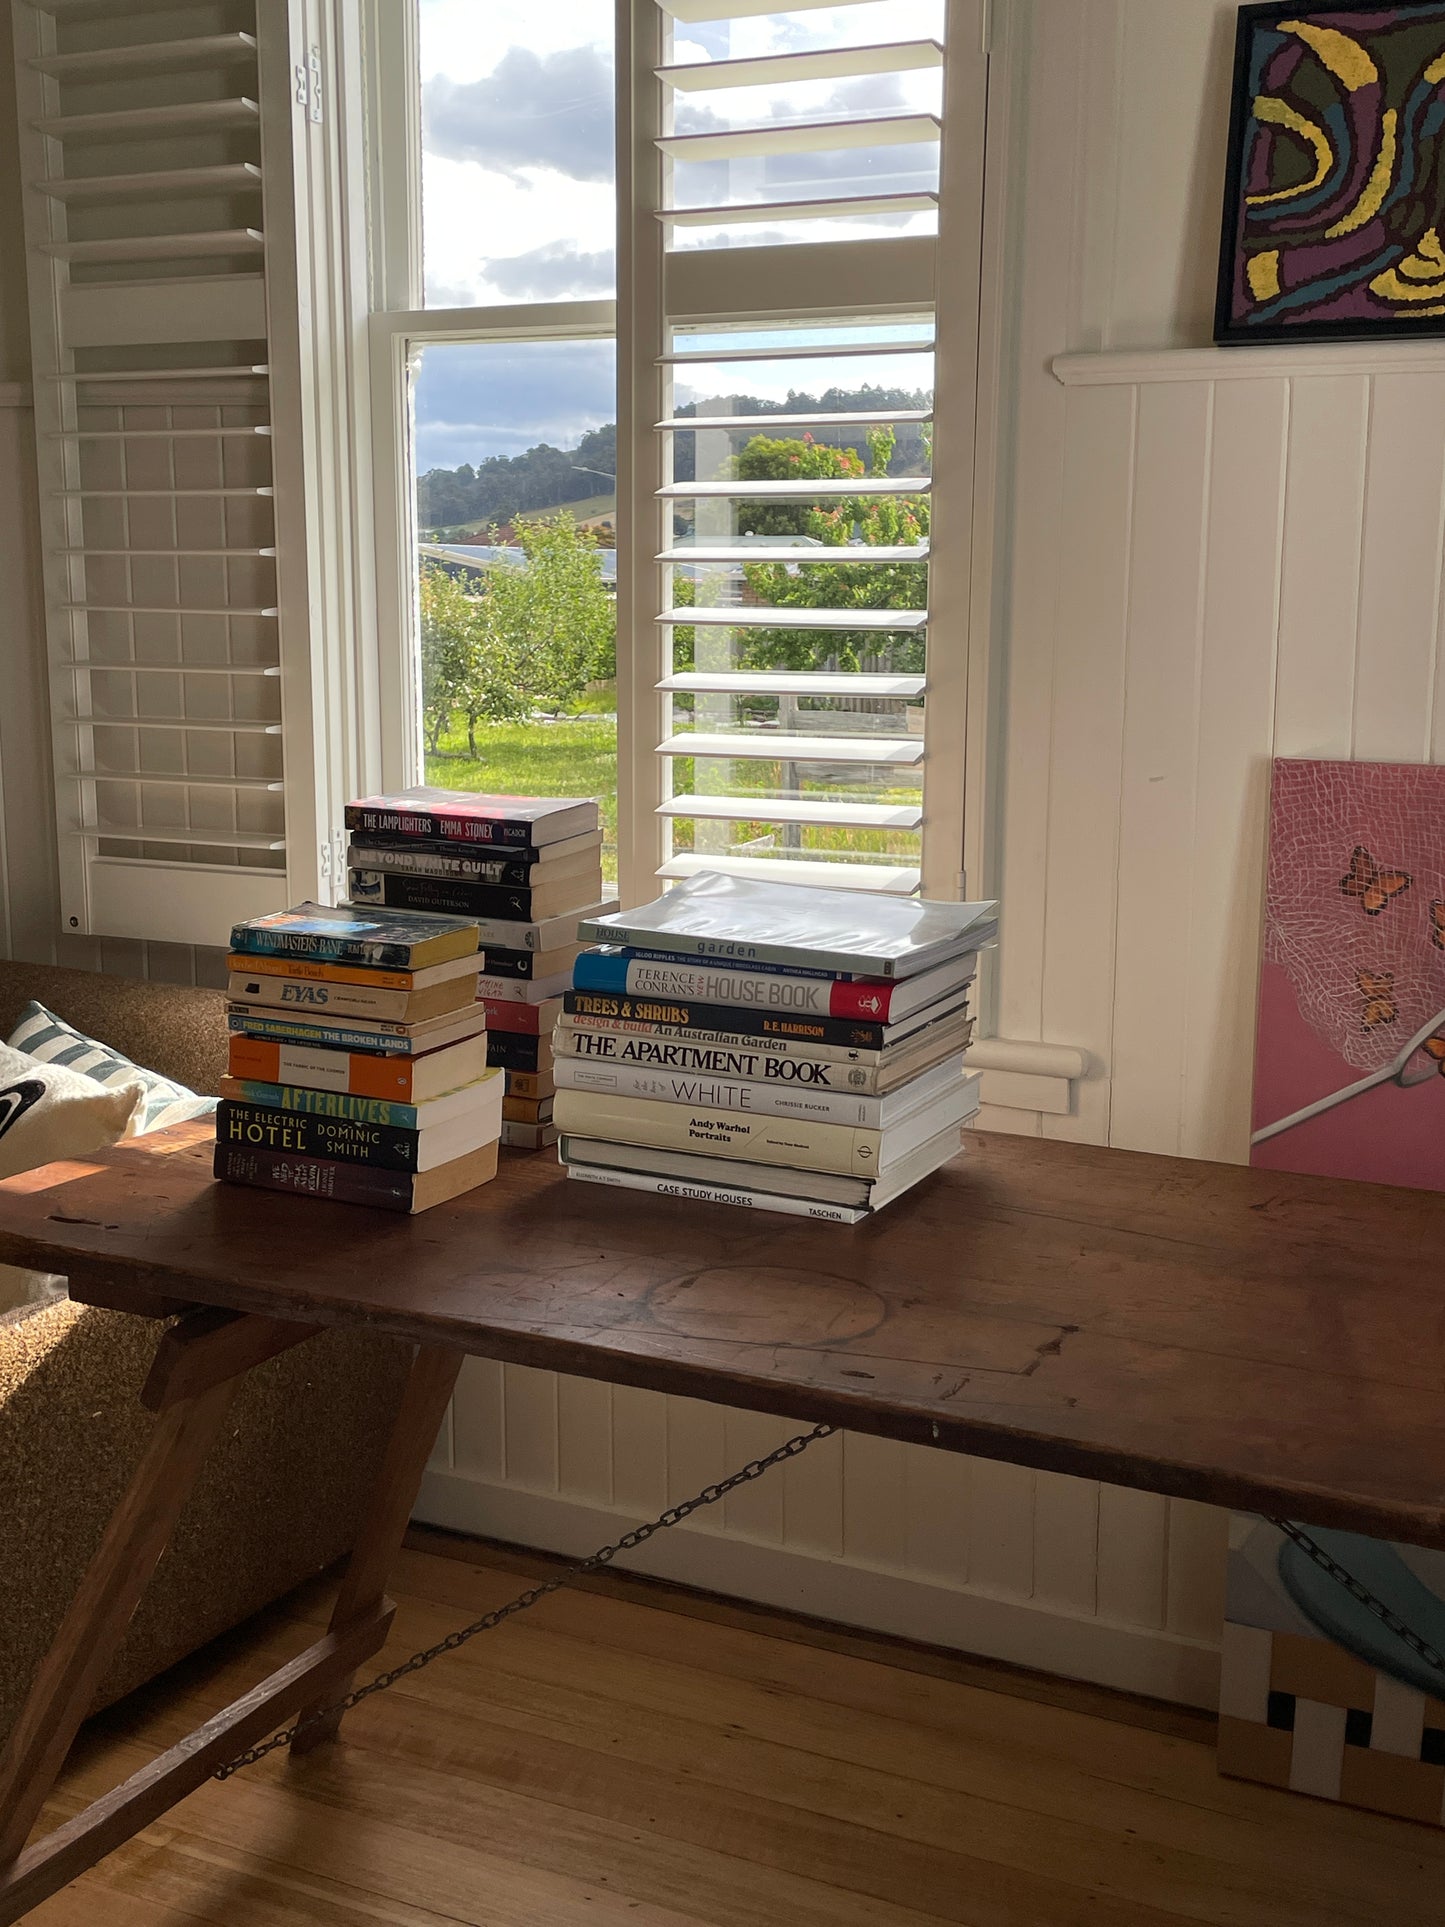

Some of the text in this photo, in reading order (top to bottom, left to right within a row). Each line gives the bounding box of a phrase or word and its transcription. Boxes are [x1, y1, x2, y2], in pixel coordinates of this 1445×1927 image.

[363, 813, 526, 839] THE LAMPLIGHTERS EMMA STONEX PICADOR
[359, 850, 412, 866] BEYOND
[413, 854, 460, 872] WHITE
[462, 860, 503, 876] GUILT
[401, 864, 422, 874] SARAH
[408, 896, 431, 904] DAVID
[595, 927, 630, 938] HOUSE
[635, 952, 652, 960] IGLOO
[653, 953, 675, 962] RIPPLES
[698, 941, 756, 958] garden
[636, 968, 694, 984] TERENCE
[280, 984, 328, 1004] EYAS
[635, 980, 694, 996] CONRAN'S
[706, 976, 820, 1010] HOUSE BOOK
[575, 996, 618, 1016] TREES
[620, 1002, 631, 1018] &
[635, 1003, 689, 1024] SHRUBS
[781, 1023, 824, 1036] HARRISON
[243, 1020, 264, 1032] FRED
[265, 1022, 320, 1039] SABERHAGEN
[323, 1032, 340, 1042] THE
[342, 1034, 378, 1046] BROKEN
[380, 1038, 408, 1050] LANDS
[573, 1014, 787, 1051] design & build An Australian Garden
[573, 1033, 832, 1085] THE APARTMENT BOOK
[281, 1087, 390, 1124] AFTERLIVES
[672, 1079, 830, 1112] WHITE CHRISSIE RUCKER
[229, 1108, 308, 1130] THE ELECTRIC
[690, 1118, 750, 1134] Andy Warhol
[229, 1120, 306, 1150] HOTEL
[317, 1123, 380, 1144] DOMINIC
[688, 1129, 731, 1143] Portraits
[326, 1141, 369, 1158] SMITH
[308, 1164, 318, 1191] KEVIN
[657, 1183, 842, 1220] CASE STUDY HOUSES TASCHEN
